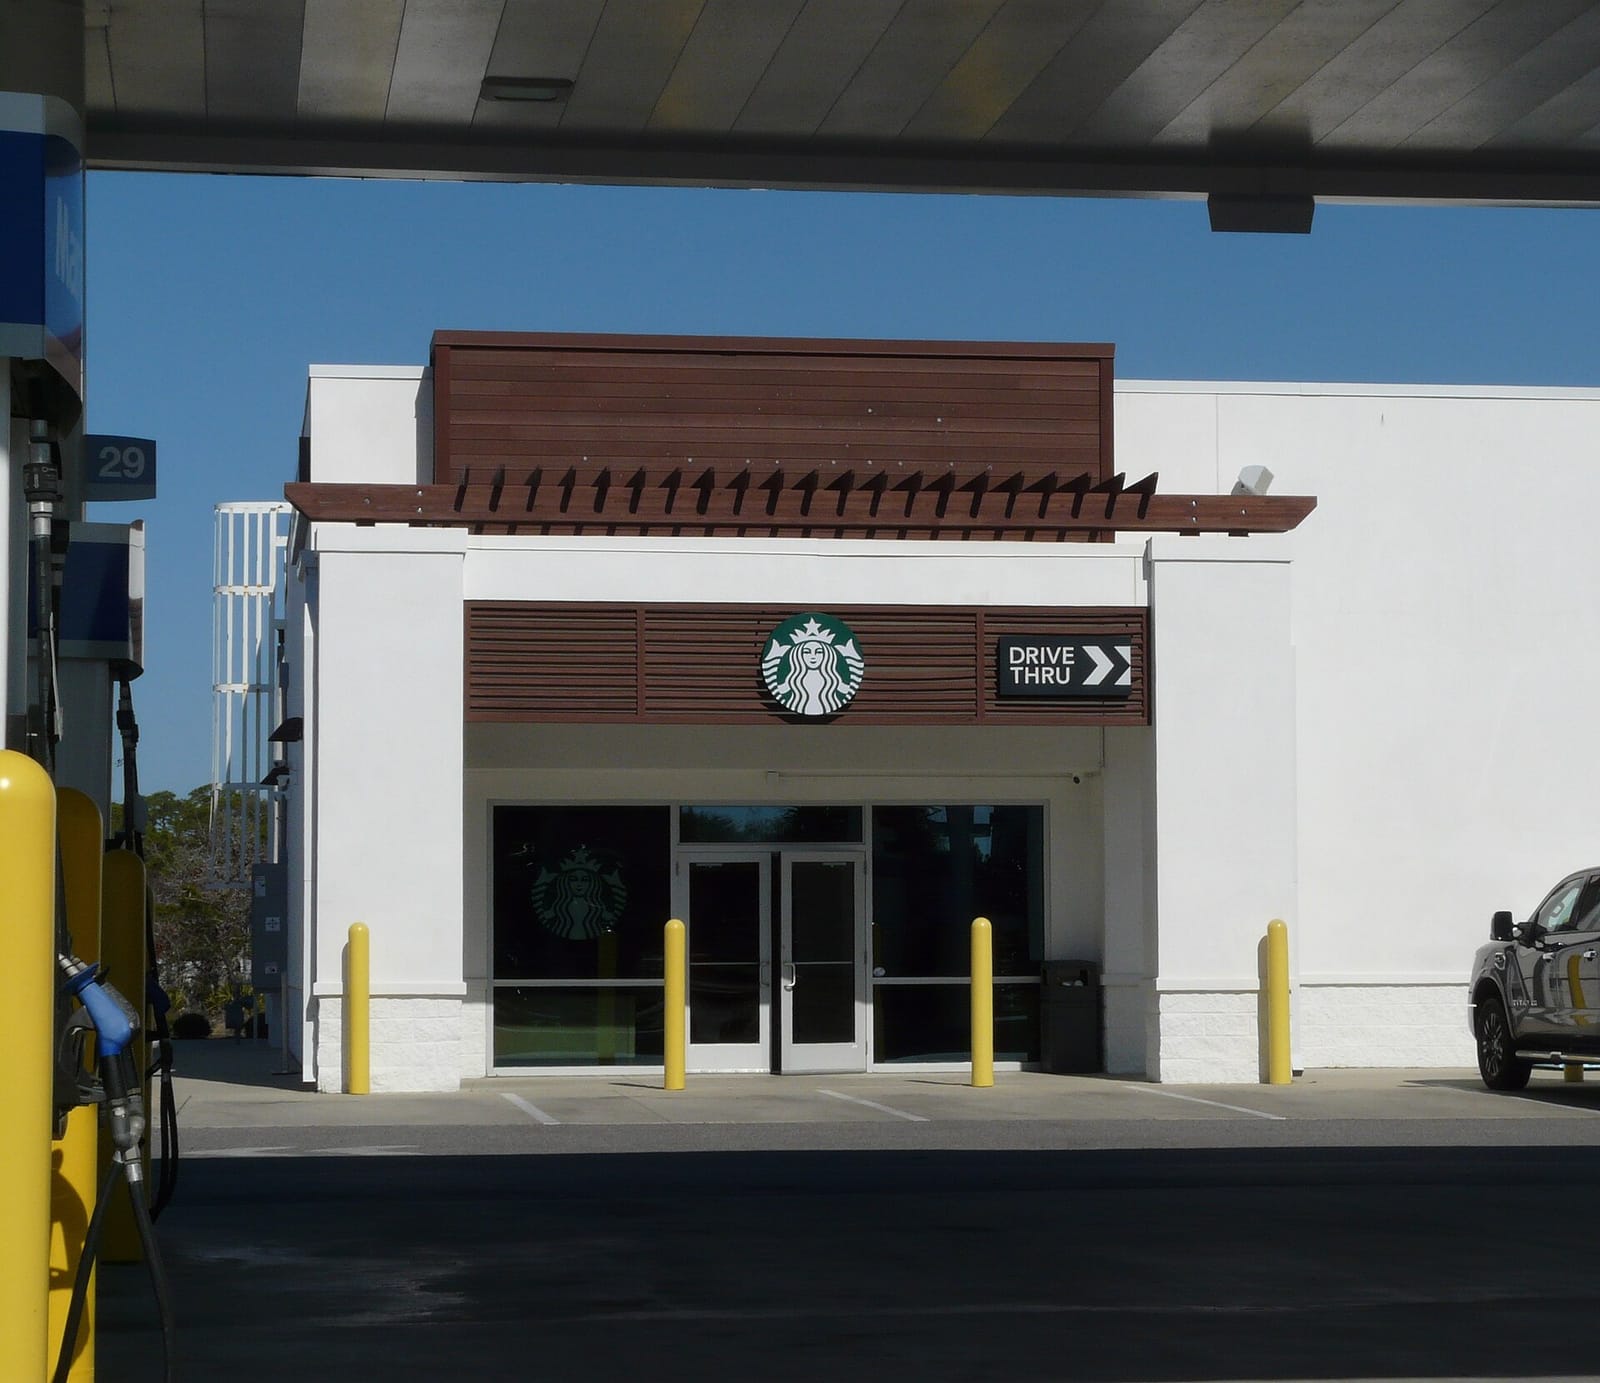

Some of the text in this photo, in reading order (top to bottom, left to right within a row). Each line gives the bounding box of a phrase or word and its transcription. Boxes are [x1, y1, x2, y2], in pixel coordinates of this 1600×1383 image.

[99, 446, 145, 478] 29
[1009, 646, 1075, 665] DRIVE
[1010, 666, 1071, 685] THRU
